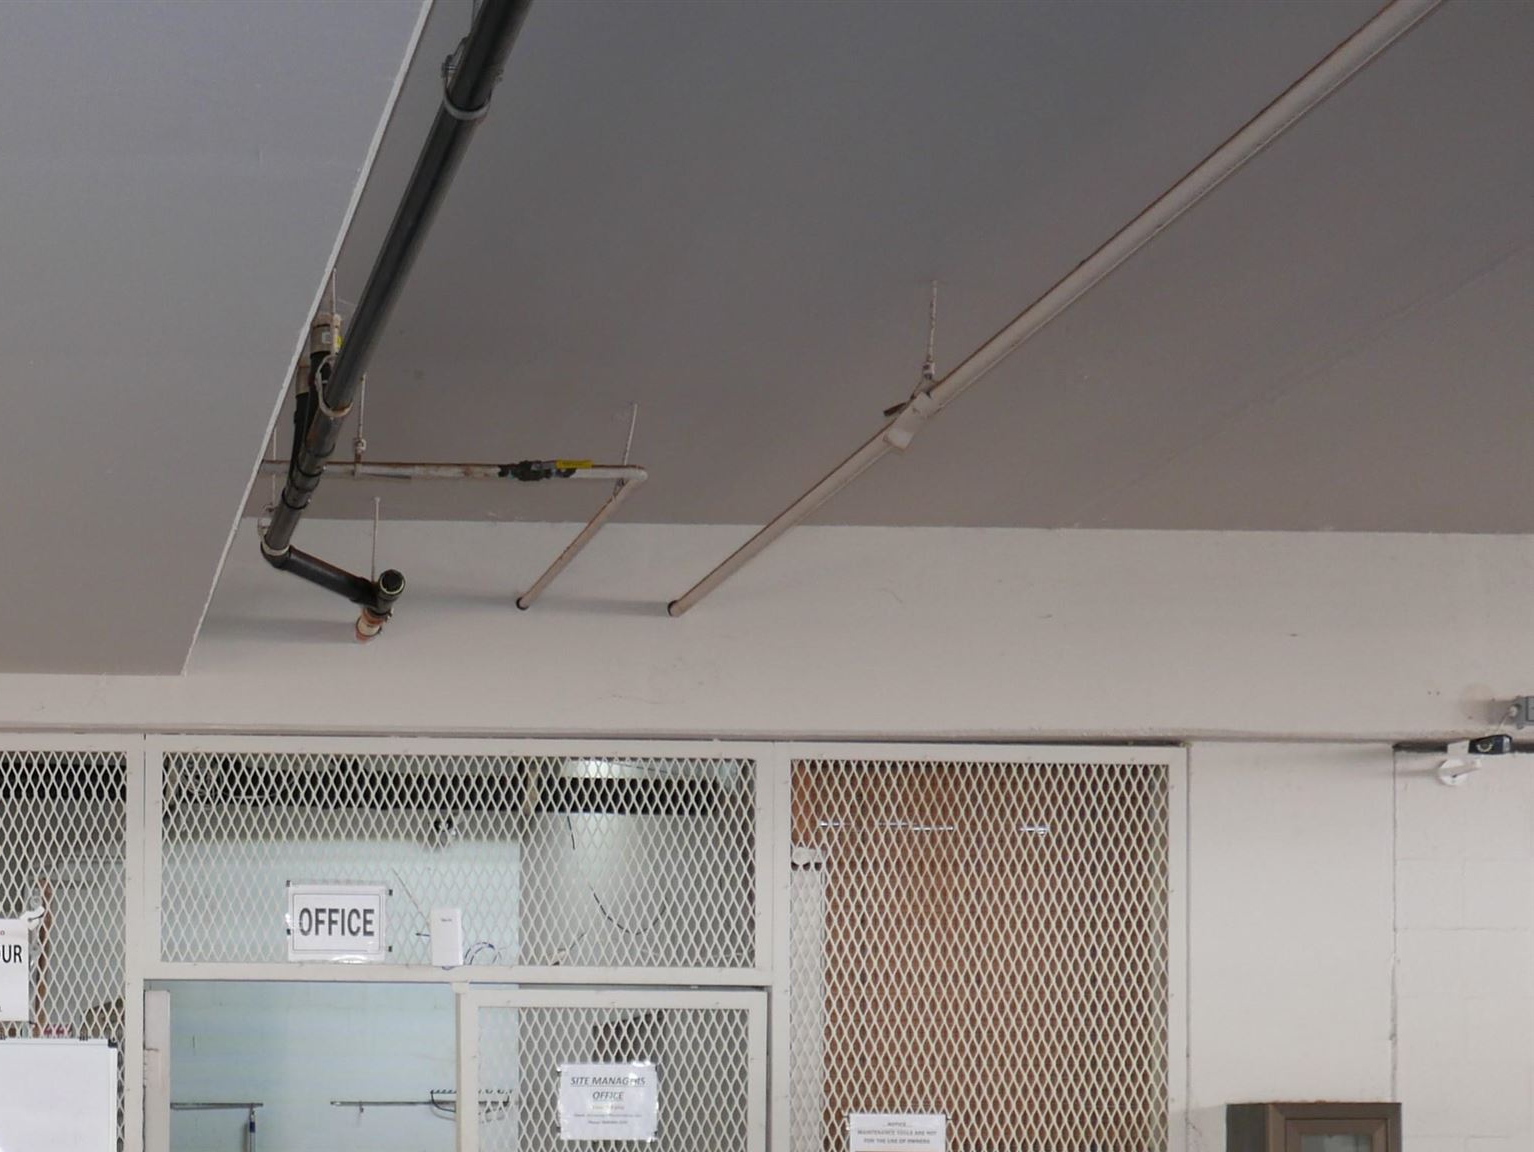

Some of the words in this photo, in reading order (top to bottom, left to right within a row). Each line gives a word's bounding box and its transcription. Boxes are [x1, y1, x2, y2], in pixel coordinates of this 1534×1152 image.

[299, 907, 375, 937] OFFICE
[570, 1076, 590, 1086] SITE
[592, 1091, 625, 1101] OFFICE
